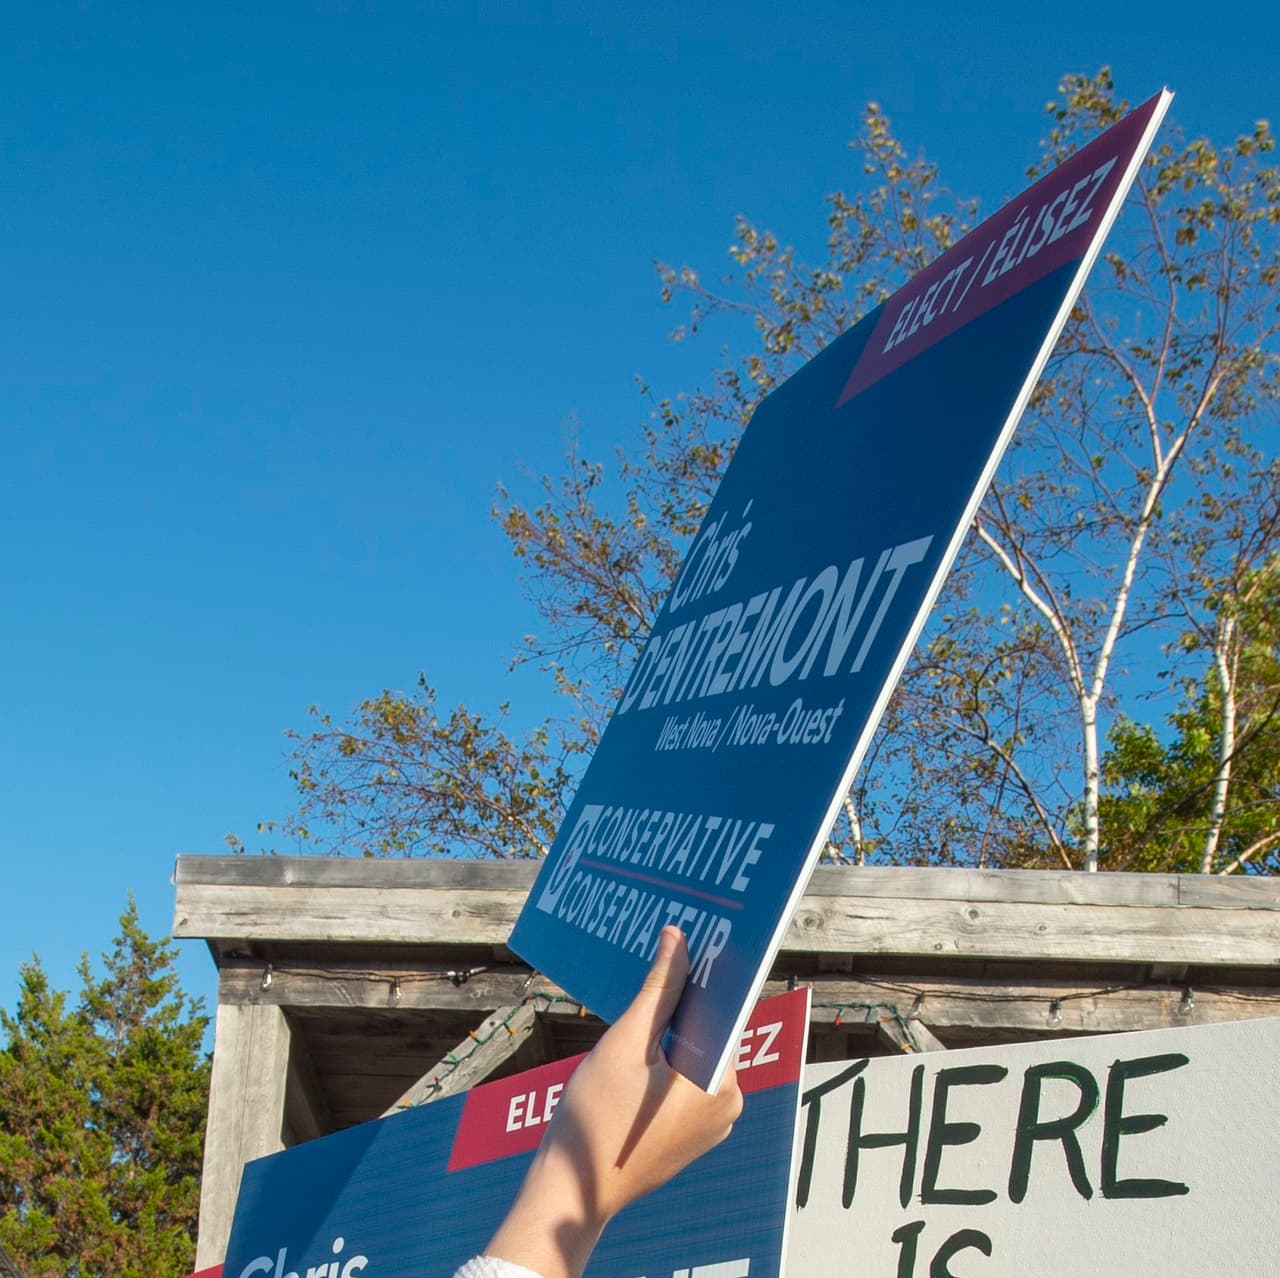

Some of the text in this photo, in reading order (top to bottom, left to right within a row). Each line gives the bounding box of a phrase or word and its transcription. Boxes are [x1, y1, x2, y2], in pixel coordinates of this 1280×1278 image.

[882, 256, 974, 354] ELECT
[981, 156, 1119, 288] ÉLISEZ
[669, 498, 754, 613] Chris
[618, 534, 934, 715] D'ENTREMONT
[655, 716, 693, 751] West
[686, 712, 721, 749] Nova
[726, 698, 846, 747] Nova-Ouest
[588, 806, 775, 892] CONSERVATIVE
[506, 1083, 564, 1133] ELE
[795, 1053, 1190, 1211] THERE
